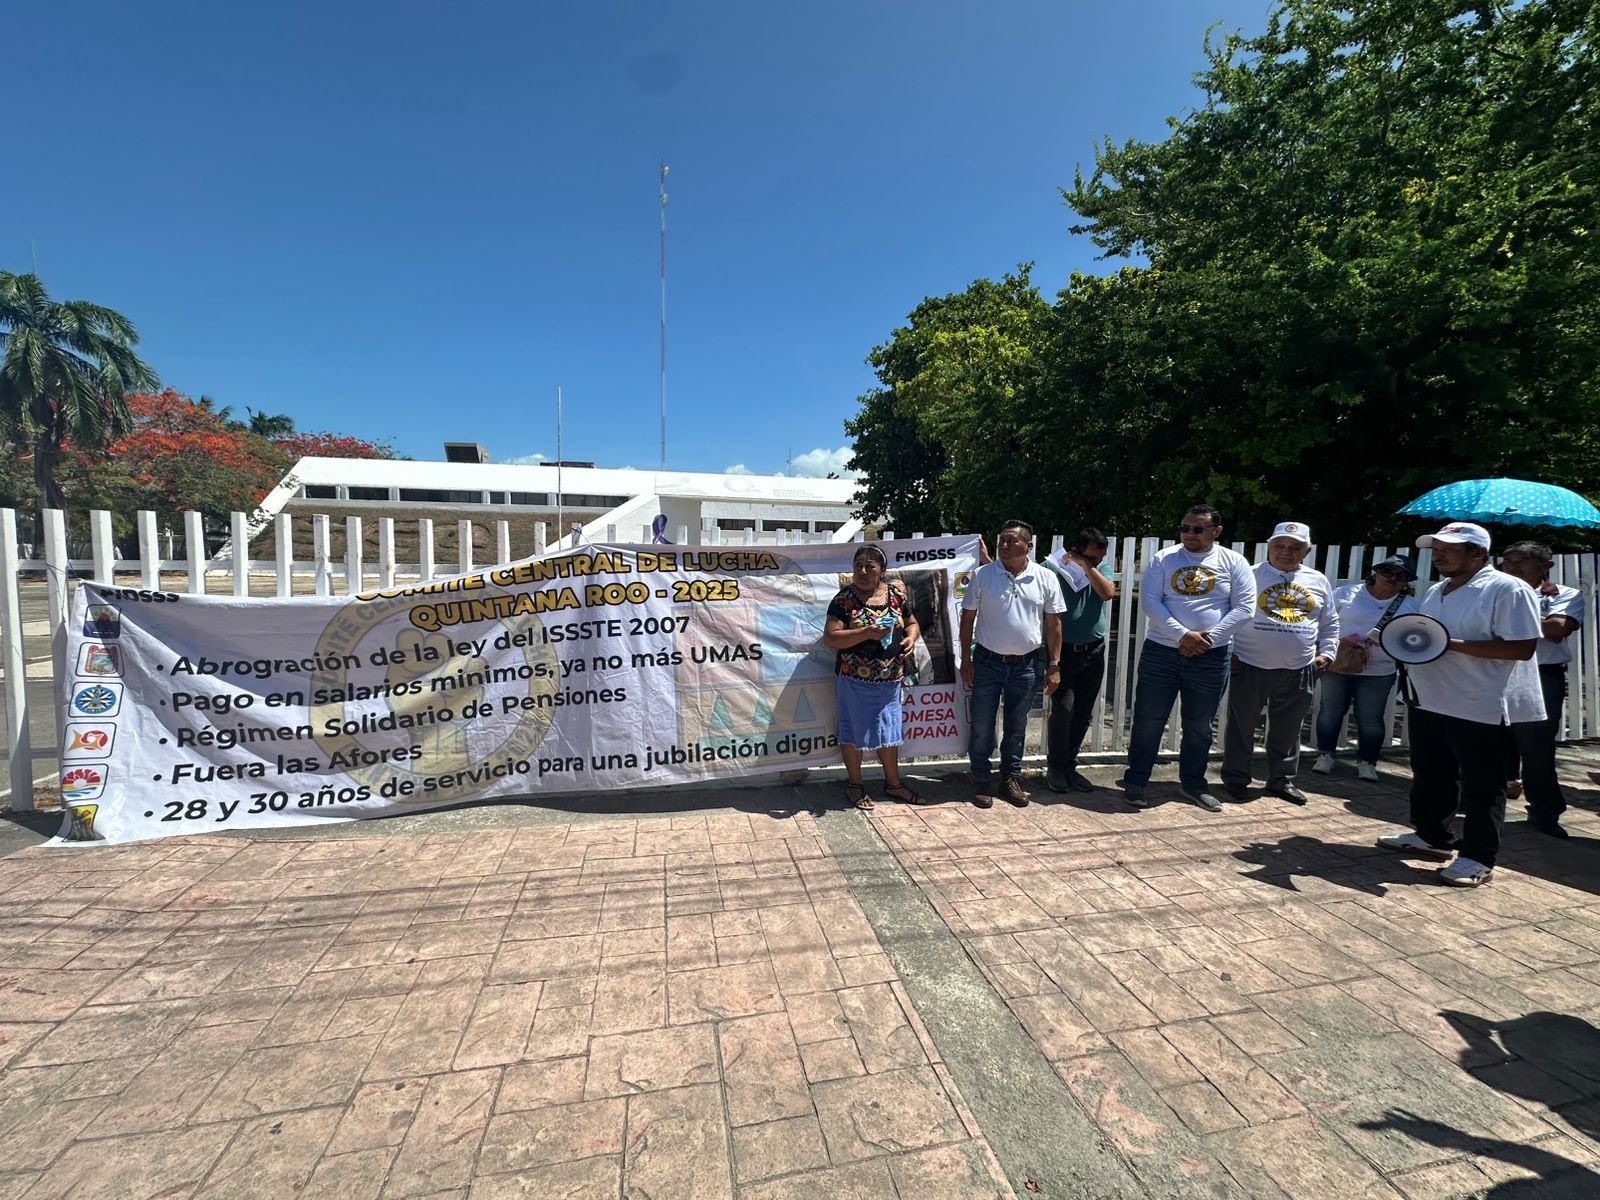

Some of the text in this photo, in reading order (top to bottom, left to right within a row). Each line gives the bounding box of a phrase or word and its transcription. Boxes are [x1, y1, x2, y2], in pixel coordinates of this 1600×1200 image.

[490, 552, 631, 586] CENTRAL
[636, 552, 677, 573] DE
[683, 552, 779, 572] LUCHA
[896, 548, 956, 562] FNDSSS
[101, 588, 179, 602] DSSS
[409, 587, 582, 632] QUINTANA
[585, 582, 650, 607] ROO
[672, 580, 740, 602] 2025
[170, 652, 361, 679] Abrogración
[370, 647, 406, 666] de
[413, 643, 439, 662] la
[448, 638, 487, 658] ley
[494, 628, 533, 650] del
[542, 619, 622, 645] ISSSTE
[629, 616, 690, 636] 2007
[172, 643, 763, 714] Pago en salarios minimos, ya no más UMAS
[902, 691, 955, 706] A CON
[902, 708, 955, 723] OMESA
[177, 687, 627, 749] Régimen Solidario de Pensiones
[905, 722, 958, 739] MPAÑA
[160, 799, 208, 822] 28
[215, 800, 240, 822] y
[248, 791, 288, 814] 30
[297, 784, 371, 808] años
[380, 777, 414, 798] de
[423, 757, 530, 792] servicio
[538, 756, 584, 777] para
[591, 752, 638, 770] una
[644, 738, 768, 771] jubilación
[775, 733, 839, 757] digna
[171, 744, 423, 785] Fuera las Afores
